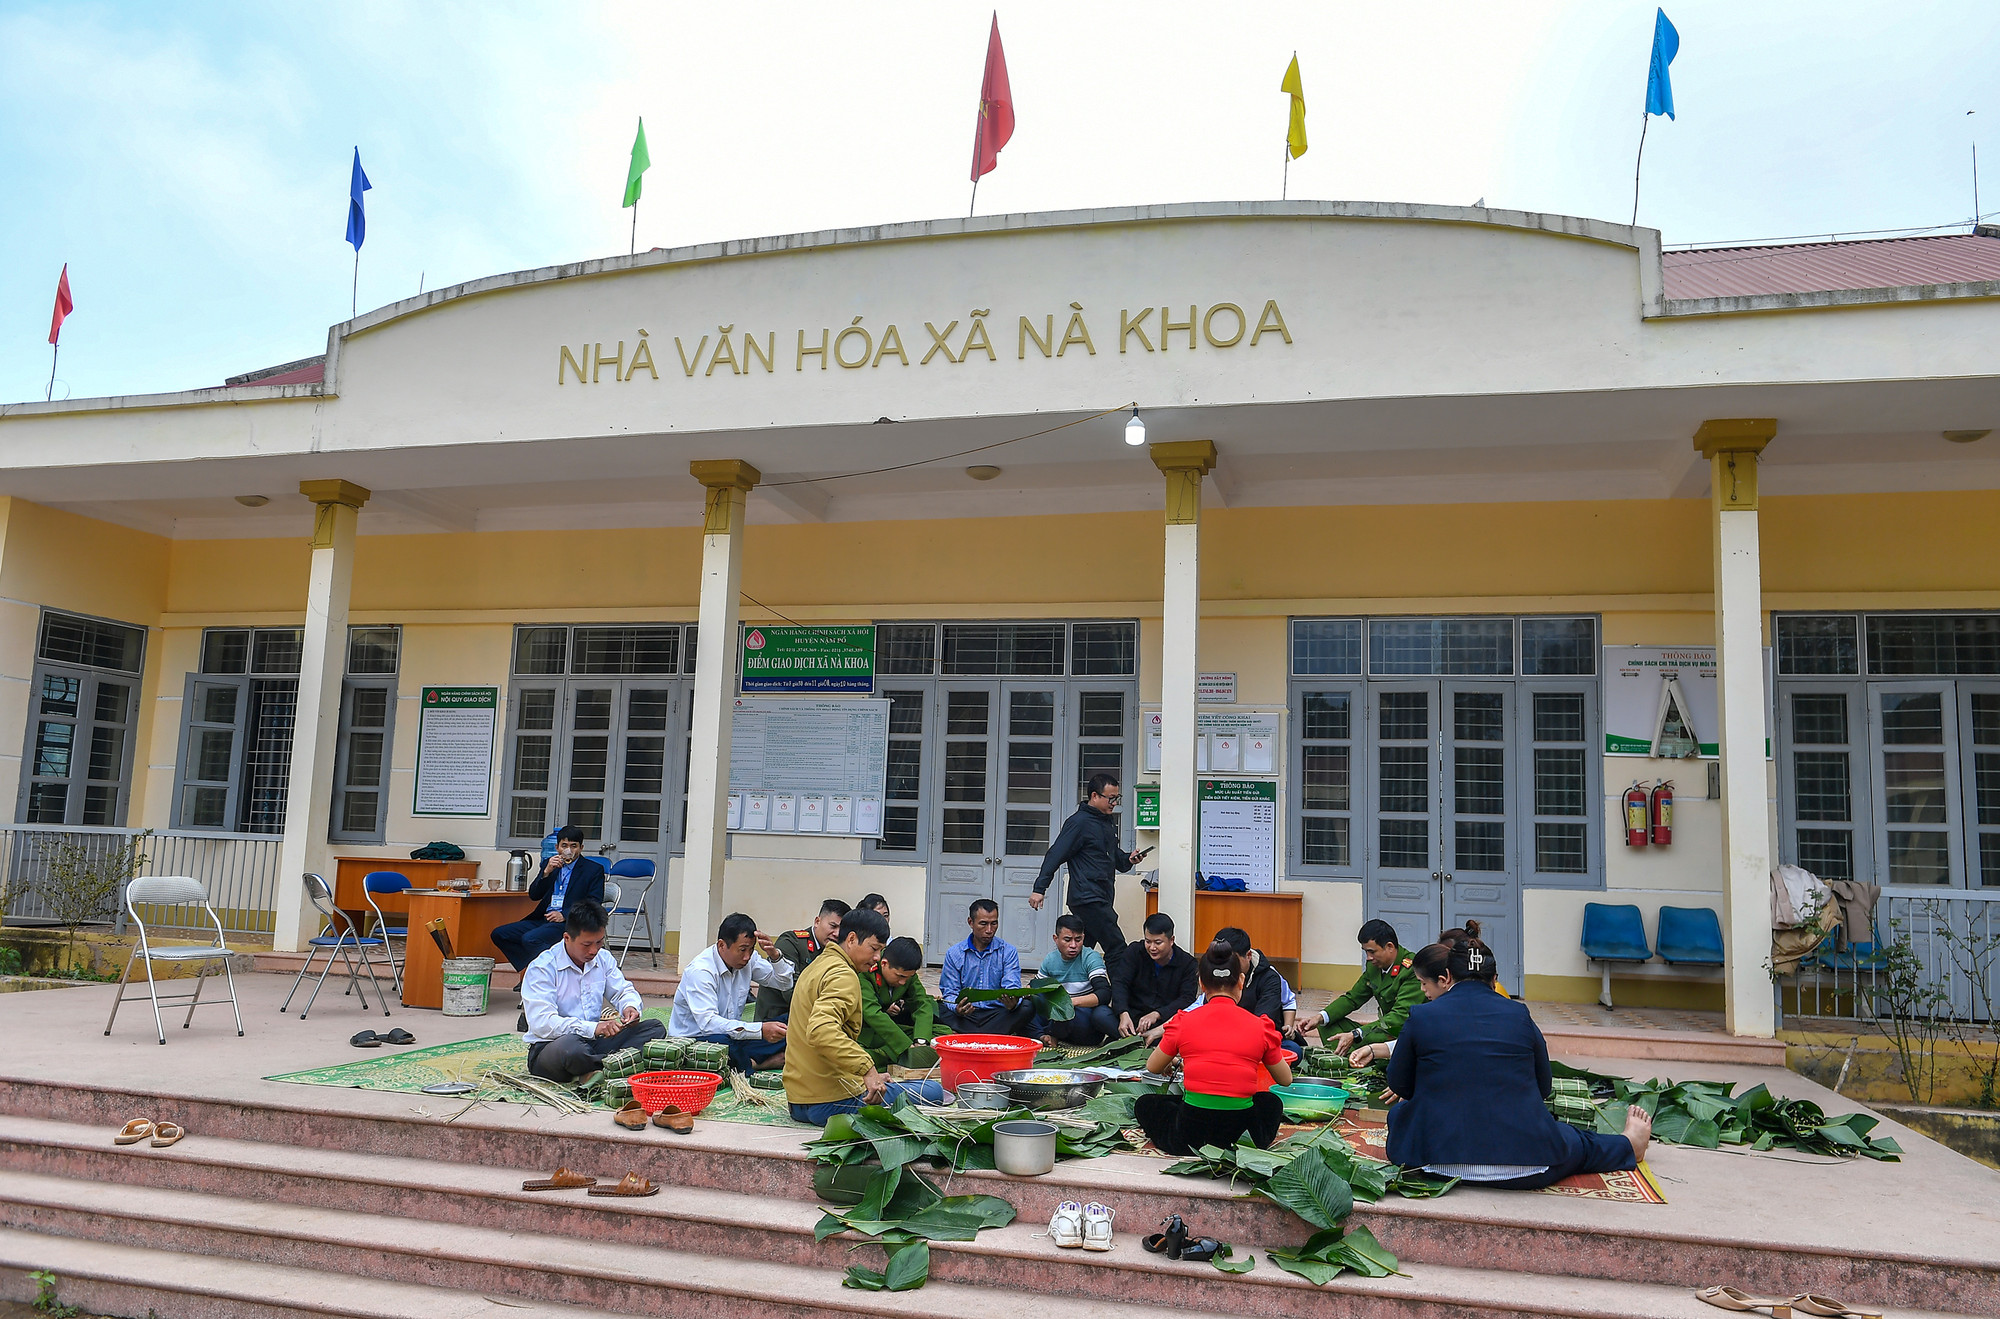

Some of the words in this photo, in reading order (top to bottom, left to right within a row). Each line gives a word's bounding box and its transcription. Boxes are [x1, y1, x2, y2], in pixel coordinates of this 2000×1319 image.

[559, 328, 659, 385] NHÀ
[674, 323, 775, 376] VĂN
[796, 315, 909, 371] HÓA
[920, 308, 997, 365] XÃ
[1018, 301, 1097, 359] NÀ
[1119, 299, 1293, 354] KHOA
[747, 651, 770, 669] ĐIỂM
[771, 657, 792, 669] GIAO
[794, 657, 815, 671] DỊCH
[816, 655, 829, 669] XÃ
[830, 653, 842, 669] NÀ
[844, 657, 869, 669] KHOA
[1661, 651, 1692, 659] THÔNG
[1693, 651, 1712, 659] BÁO
[440, 696, 450, 704] NỘI
[478, 696, 492, 704] DỊCH
